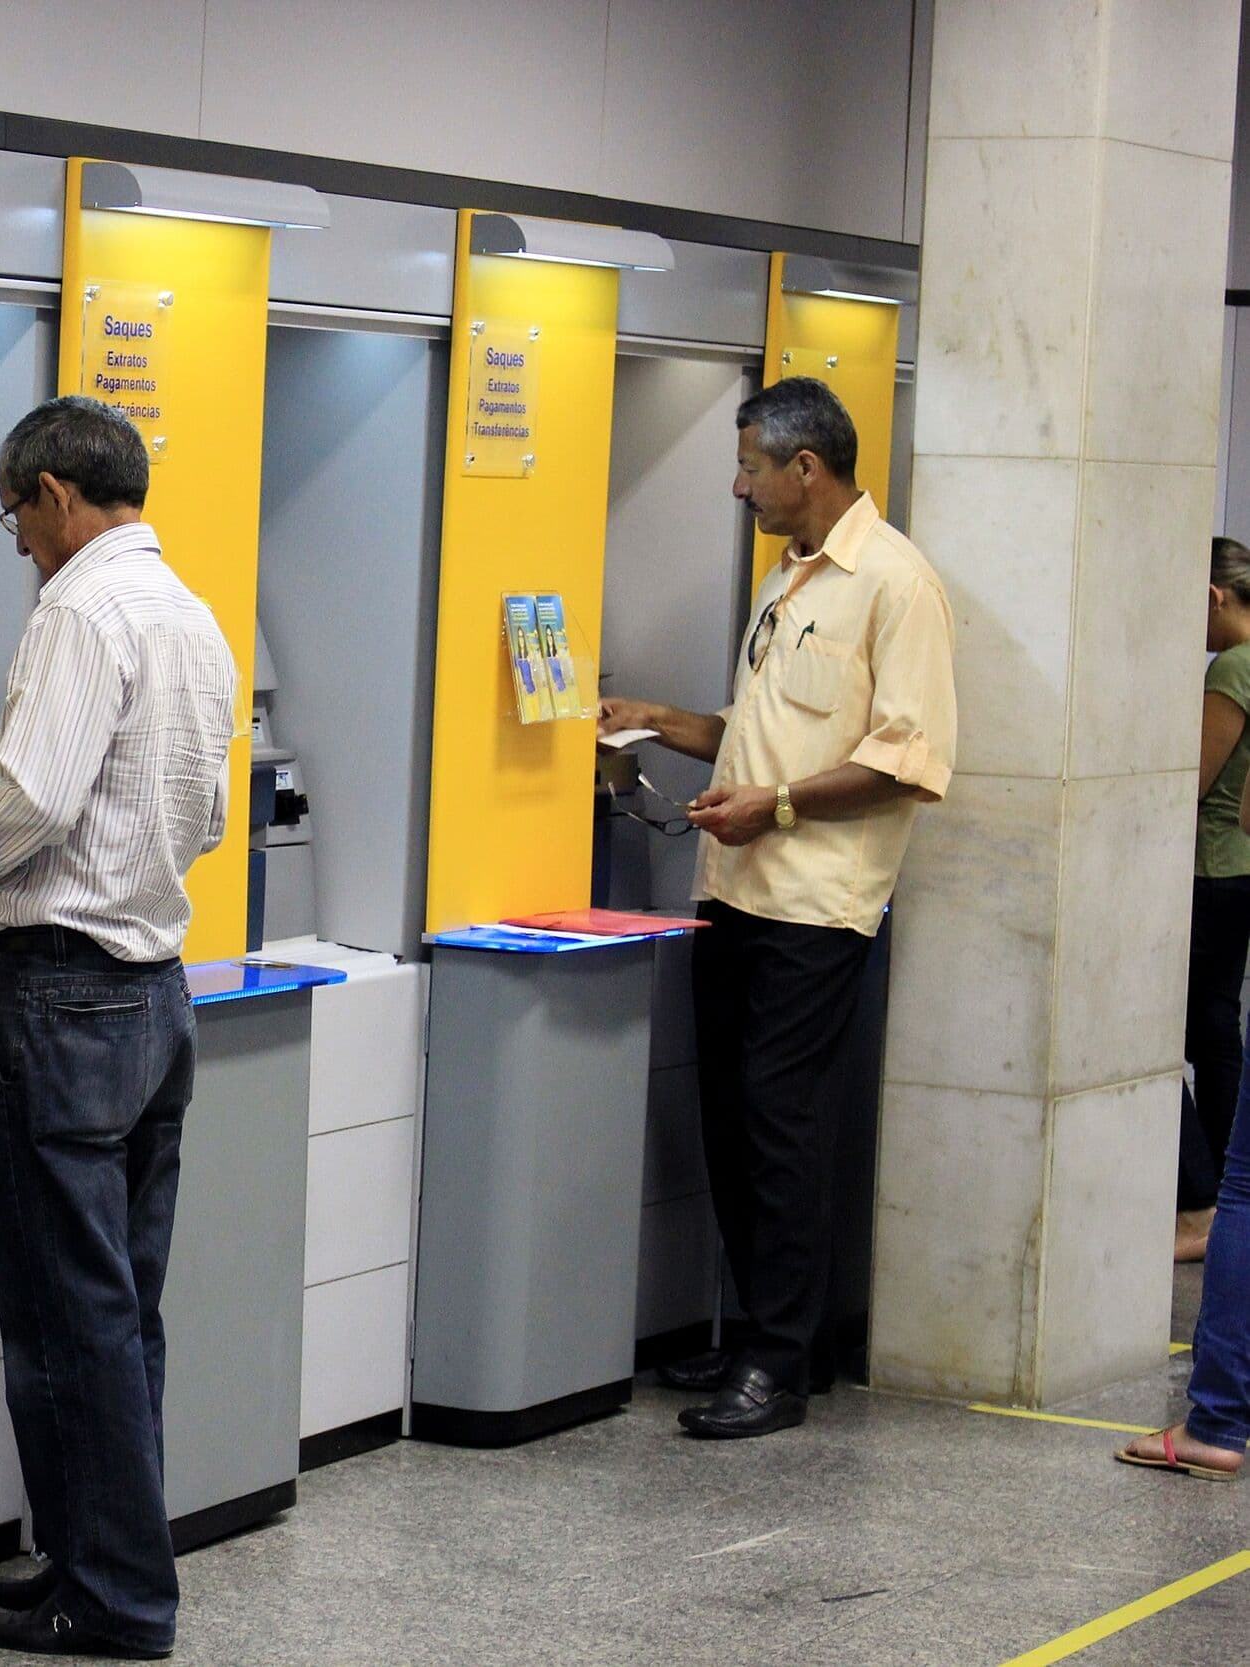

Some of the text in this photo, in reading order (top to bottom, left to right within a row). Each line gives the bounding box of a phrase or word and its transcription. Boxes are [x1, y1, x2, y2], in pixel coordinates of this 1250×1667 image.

[104, 315, 153, 342] Saques
[107, 351, 148, 368] Extratos
[486, 347, 525, 370] Saques
[96, 374, 157, 394] Pagamentos
[488, 378, 520, 393] Extratos
[112, 401, 161, 419] frências
[478, 398, 527, 416] Pagamentos
[474, 421, 530, 438] Transferências
